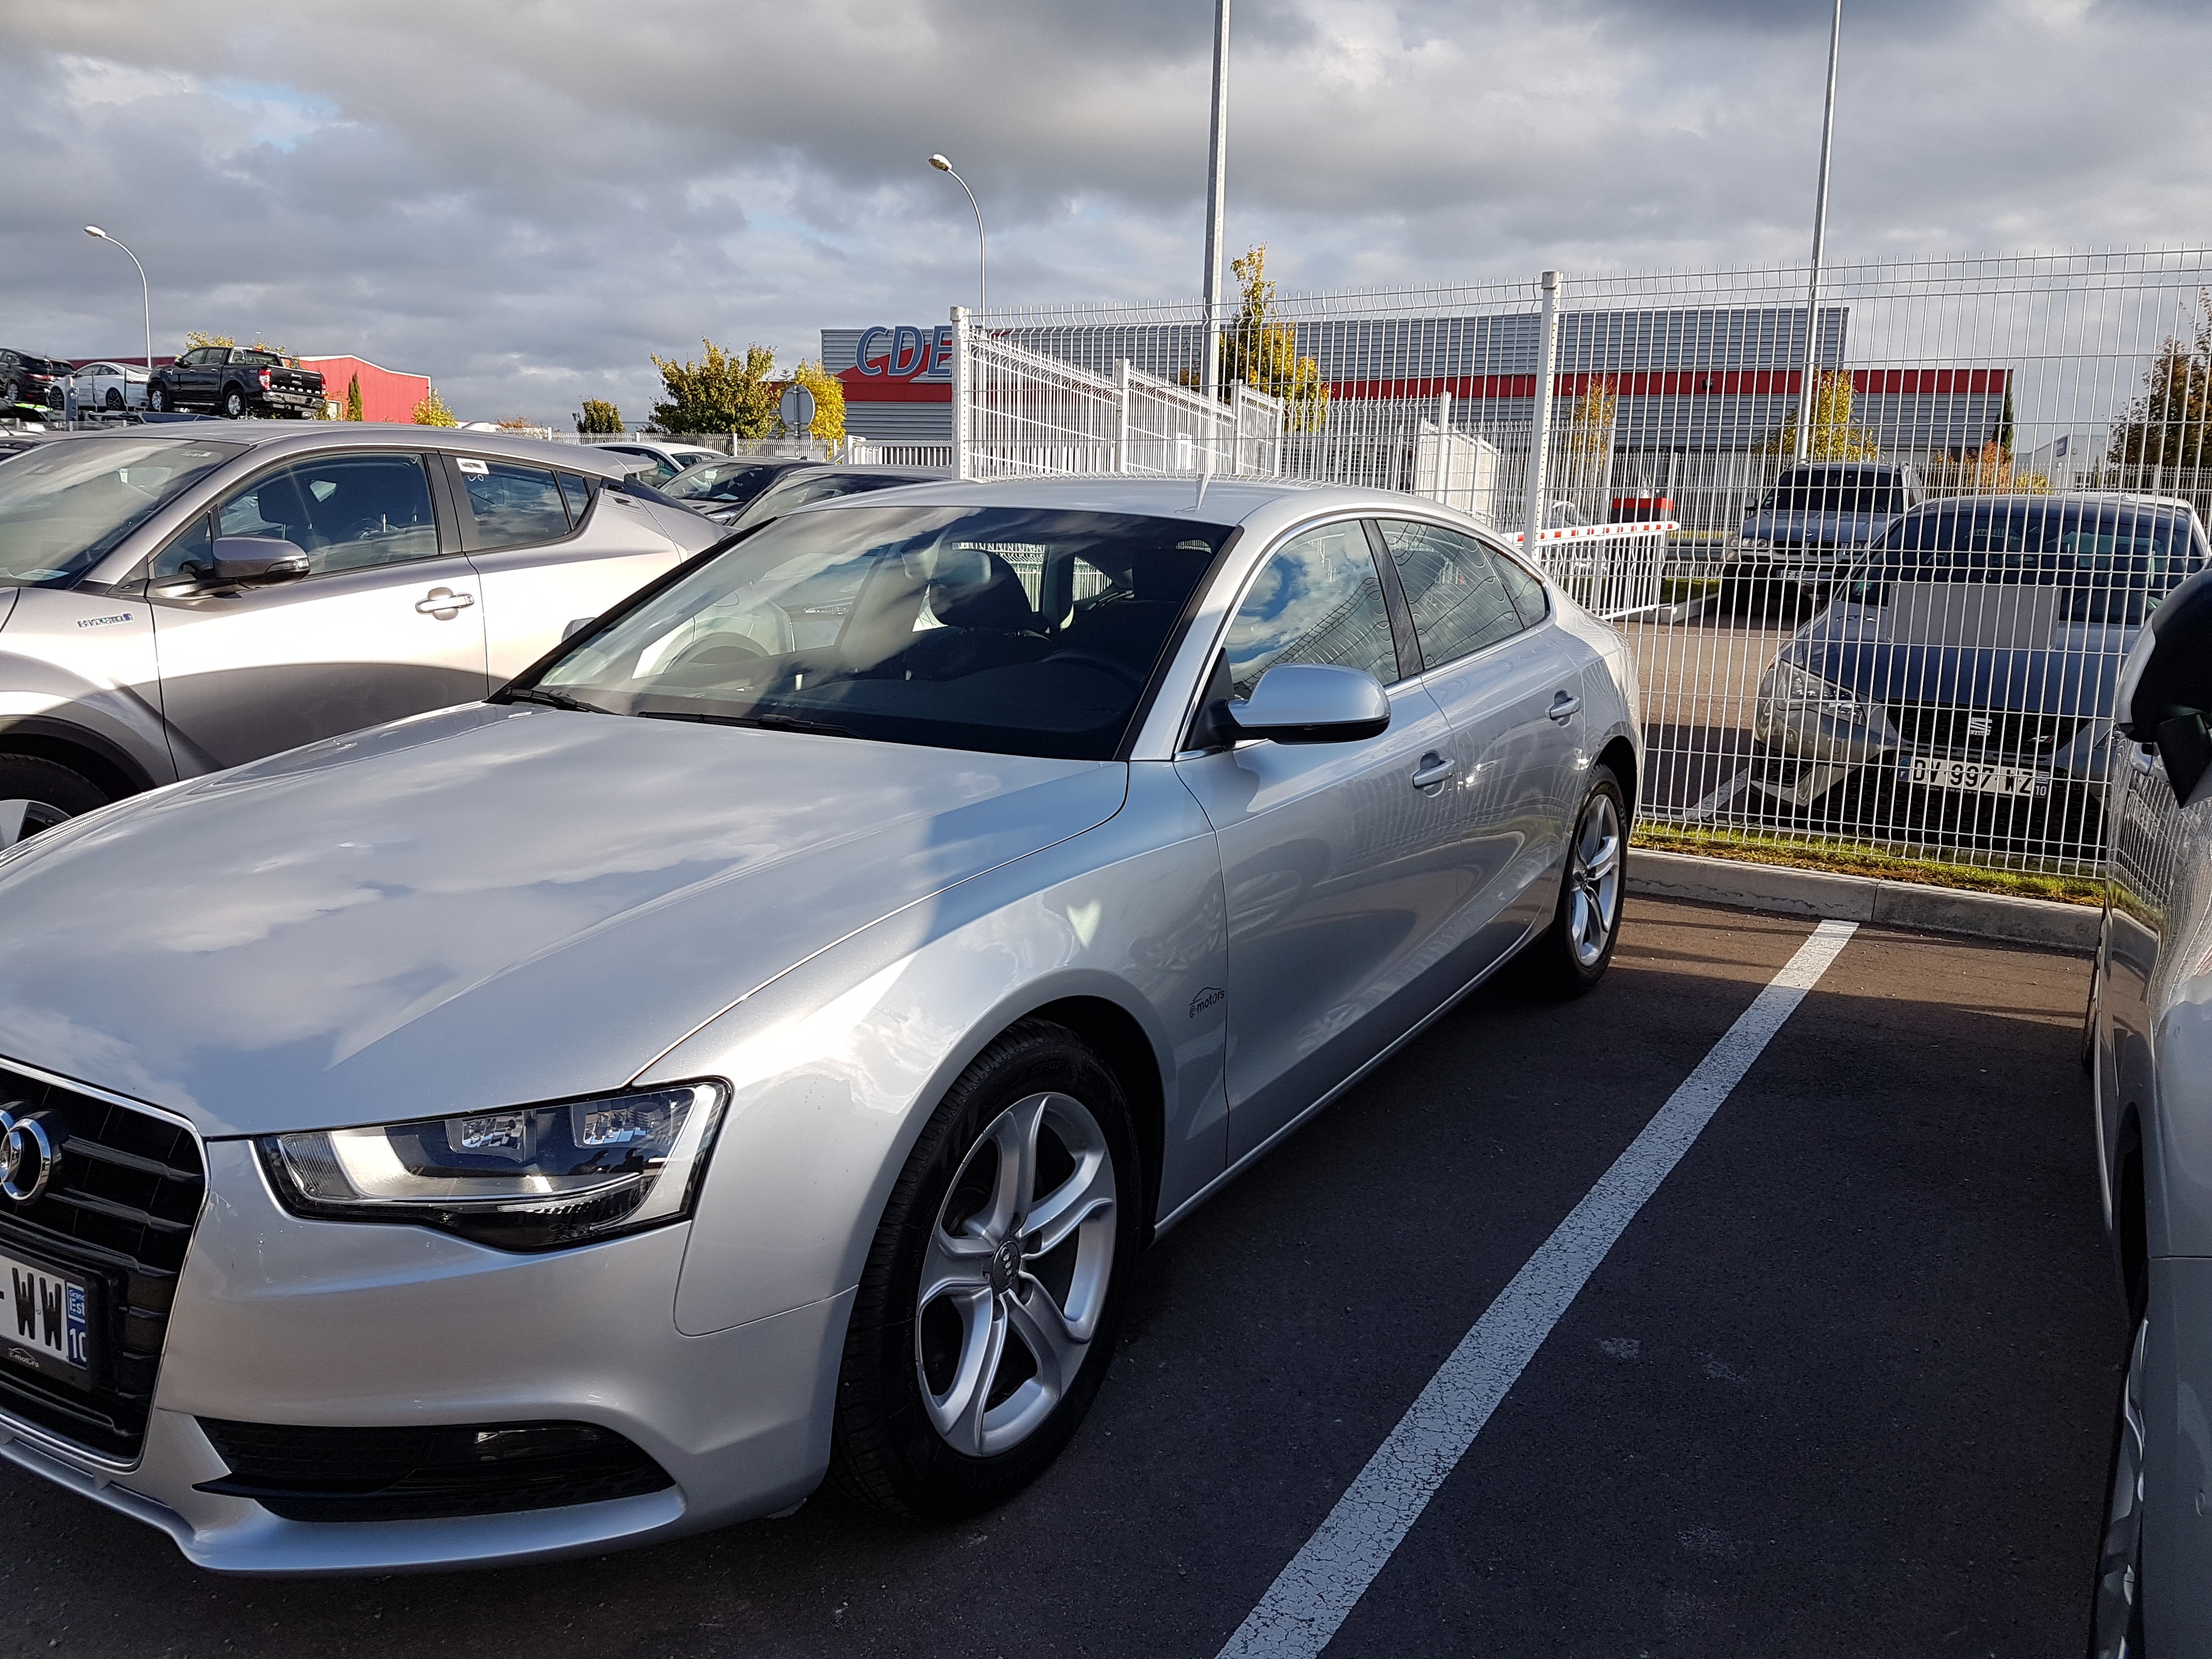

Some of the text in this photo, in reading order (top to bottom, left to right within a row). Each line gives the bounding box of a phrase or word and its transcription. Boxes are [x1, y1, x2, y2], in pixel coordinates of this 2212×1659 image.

[855, 325, 952, 376] CDE
[271, 383, 321, 395] RANGER
[2035, 785, 2047, 796] 10
